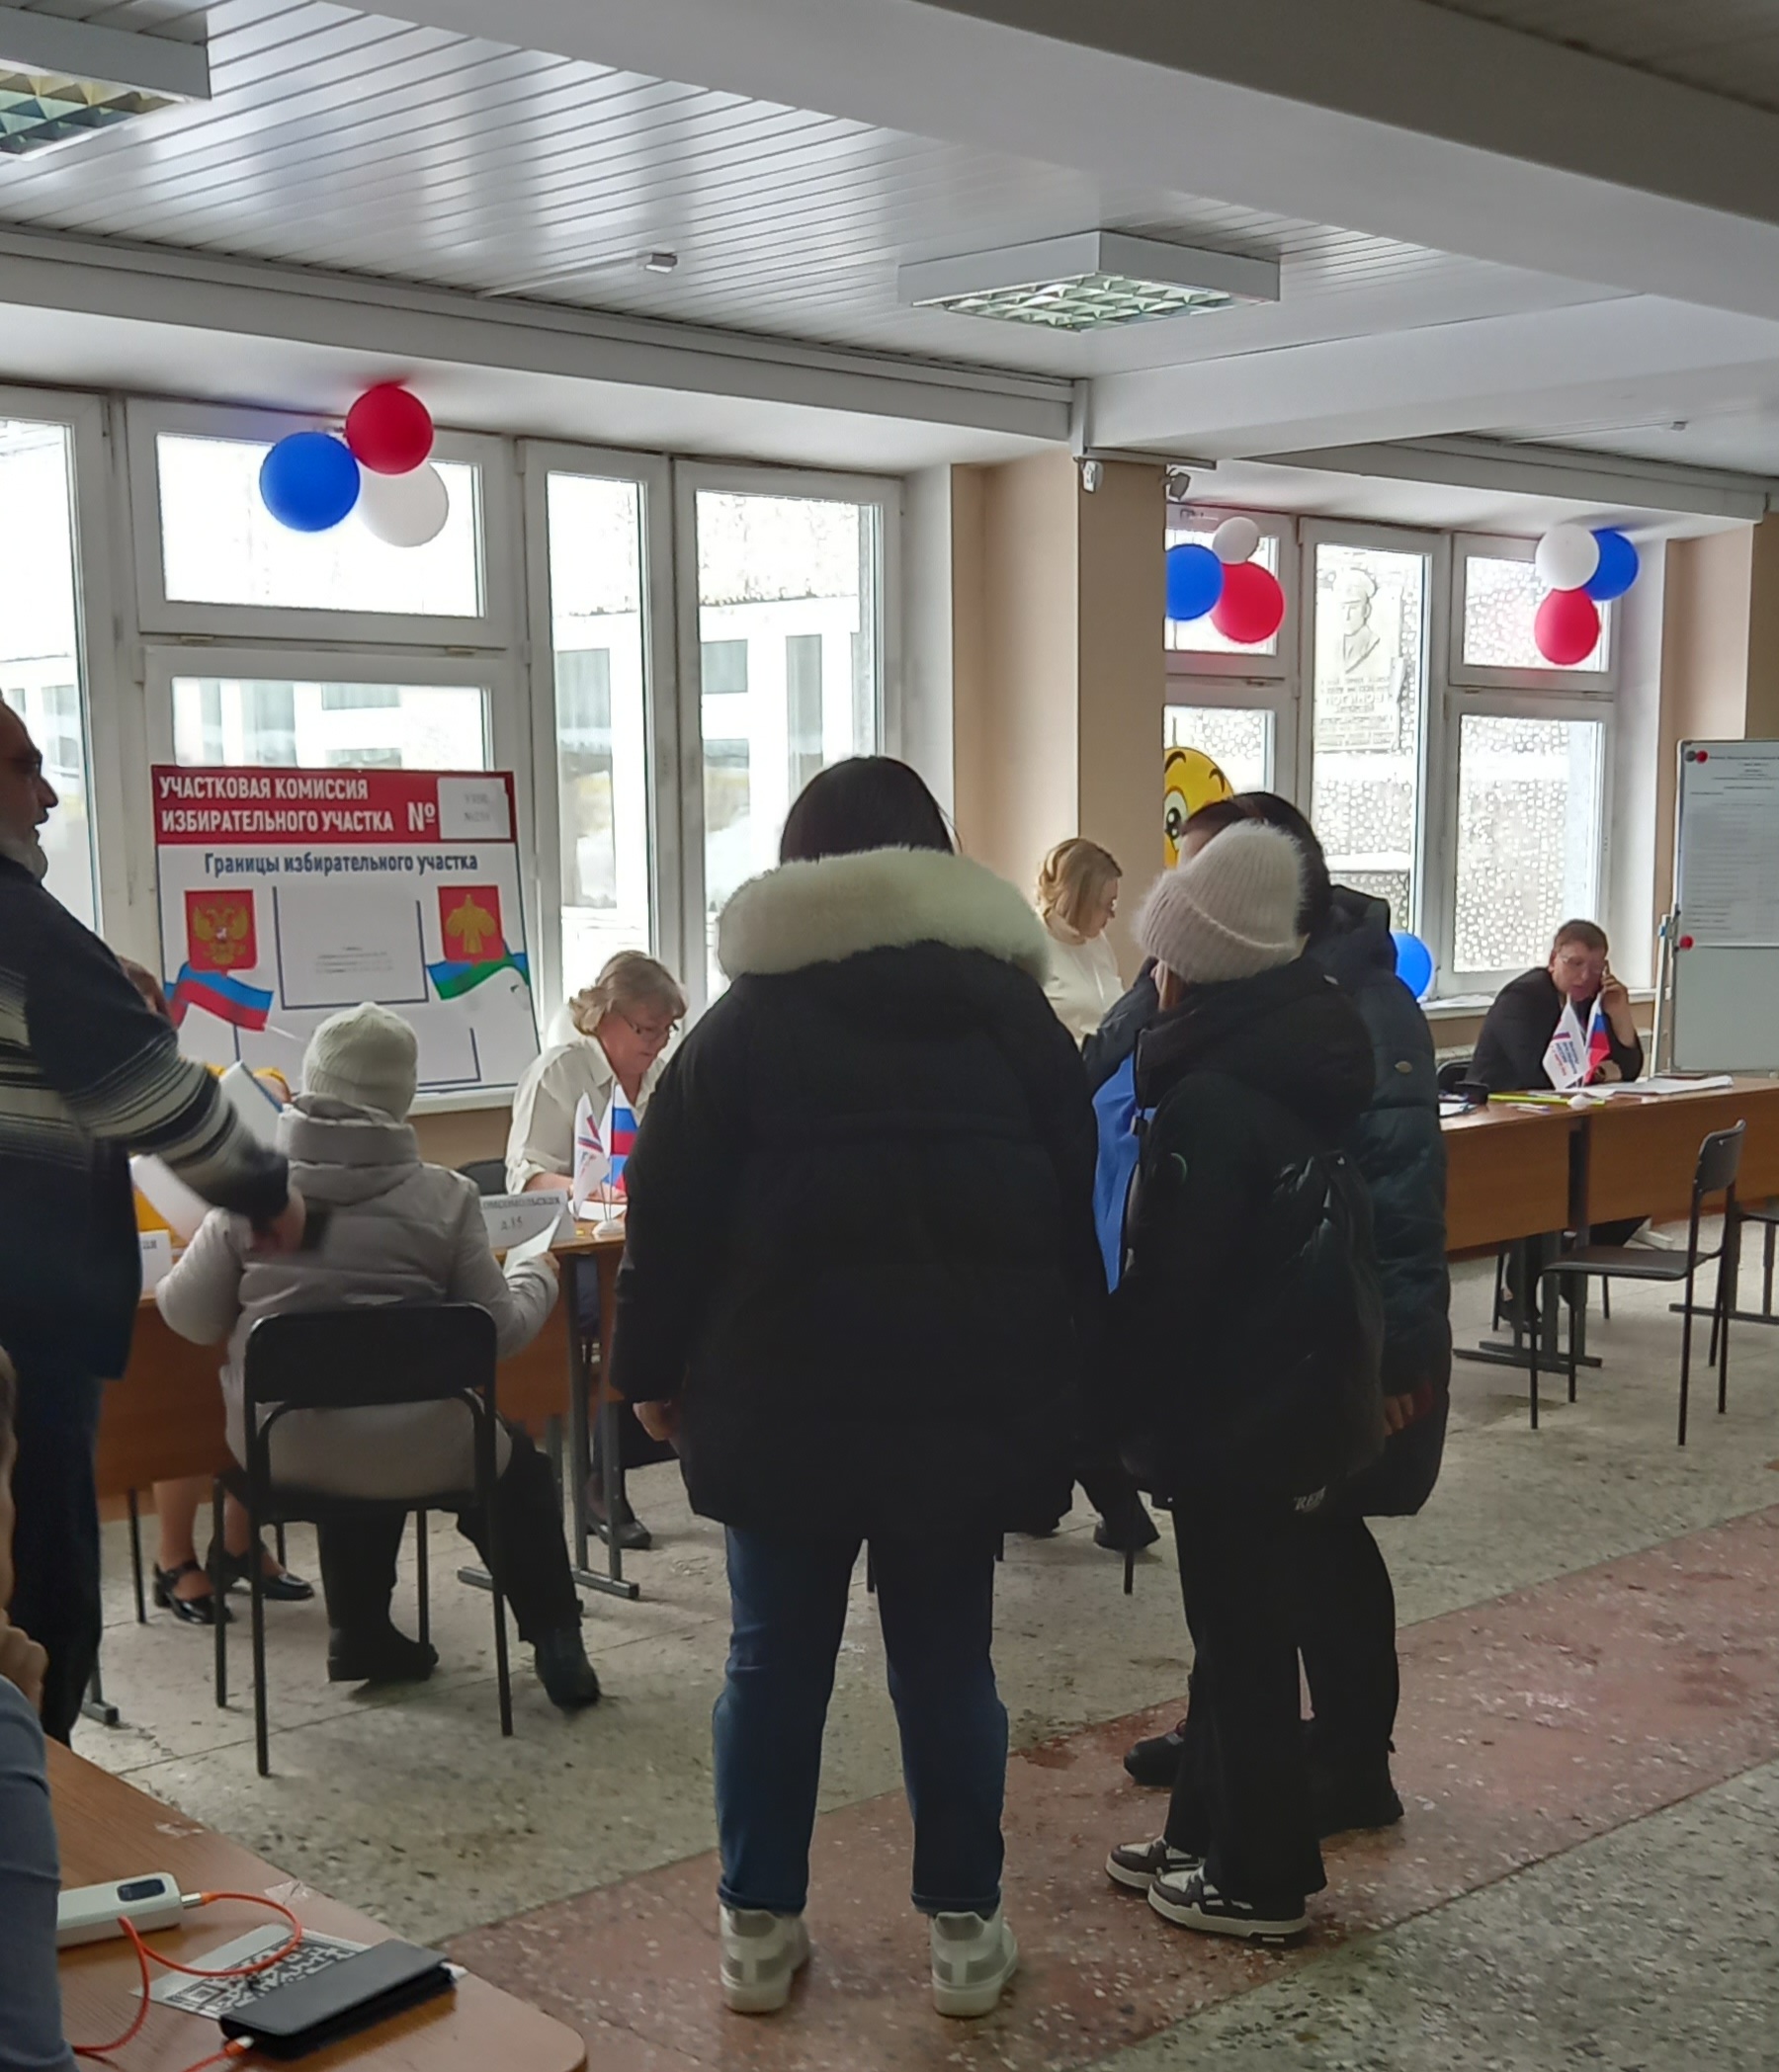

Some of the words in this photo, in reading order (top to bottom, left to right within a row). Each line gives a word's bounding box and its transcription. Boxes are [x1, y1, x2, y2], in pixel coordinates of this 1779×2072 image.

[159, 776, 271, 799] УЧАСТКОВАЯ
[275, 778, 369, 800] КОМИССИЯ
[161, 809, 318, 833] ИЗБИРАТЕЛЬНОГО
[322, 810, 394, 833] УЧАСТКА
[205, 852, 280, 877] Границы
[284, 852, 413, 877] избирательного
[418, 854, 478, 876] участка
